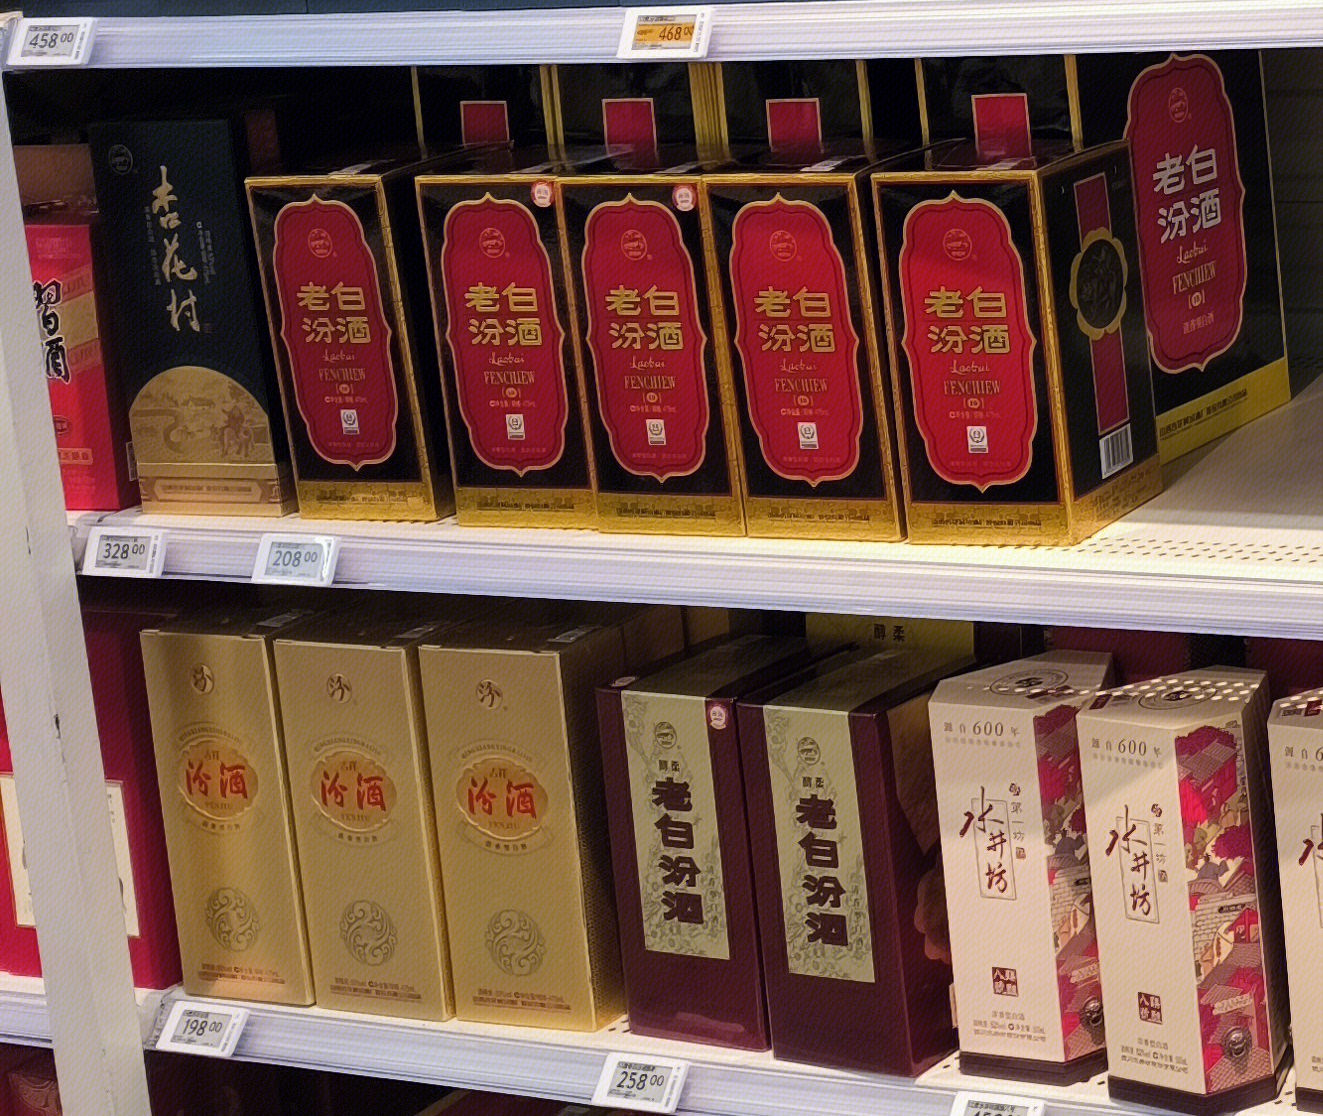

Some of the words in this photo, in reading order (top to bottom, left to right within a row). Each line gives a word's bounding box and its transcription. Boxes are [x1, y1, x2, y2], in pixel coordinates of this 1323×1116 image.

[1152, 143, 1219, 196] 老白
[1157, 188, 1222, 245] 汾酒
[297, 282, 366, 312] 老白
[464, 281, 539, 314] 老白
[605, 284, 681, 317] 老白
[754, 285, 831, 319] 老白
[924, 285, 1007, 318] 老白
[302, 315, 372, 344] 汾酒
[467, 317, 543, 347] 汾酒
[608, 321, 684, 352] 汾酒
[757, 322, 836, 353] 汾酒
[927, 323, 1011, 355] 汾酒
[185, 760, 249, 800] 汾酒
[320, 771, 387, 812] 汾酒
[467, 777, 537, 820] 汾酒
[651, 777, 705, 925] 老白汾酒
[959, 786, 1010, 894] 水井坊
[796, 793, 848, 947] 老白汾酒
[1105, 804, 1152, 917] 水井坊
